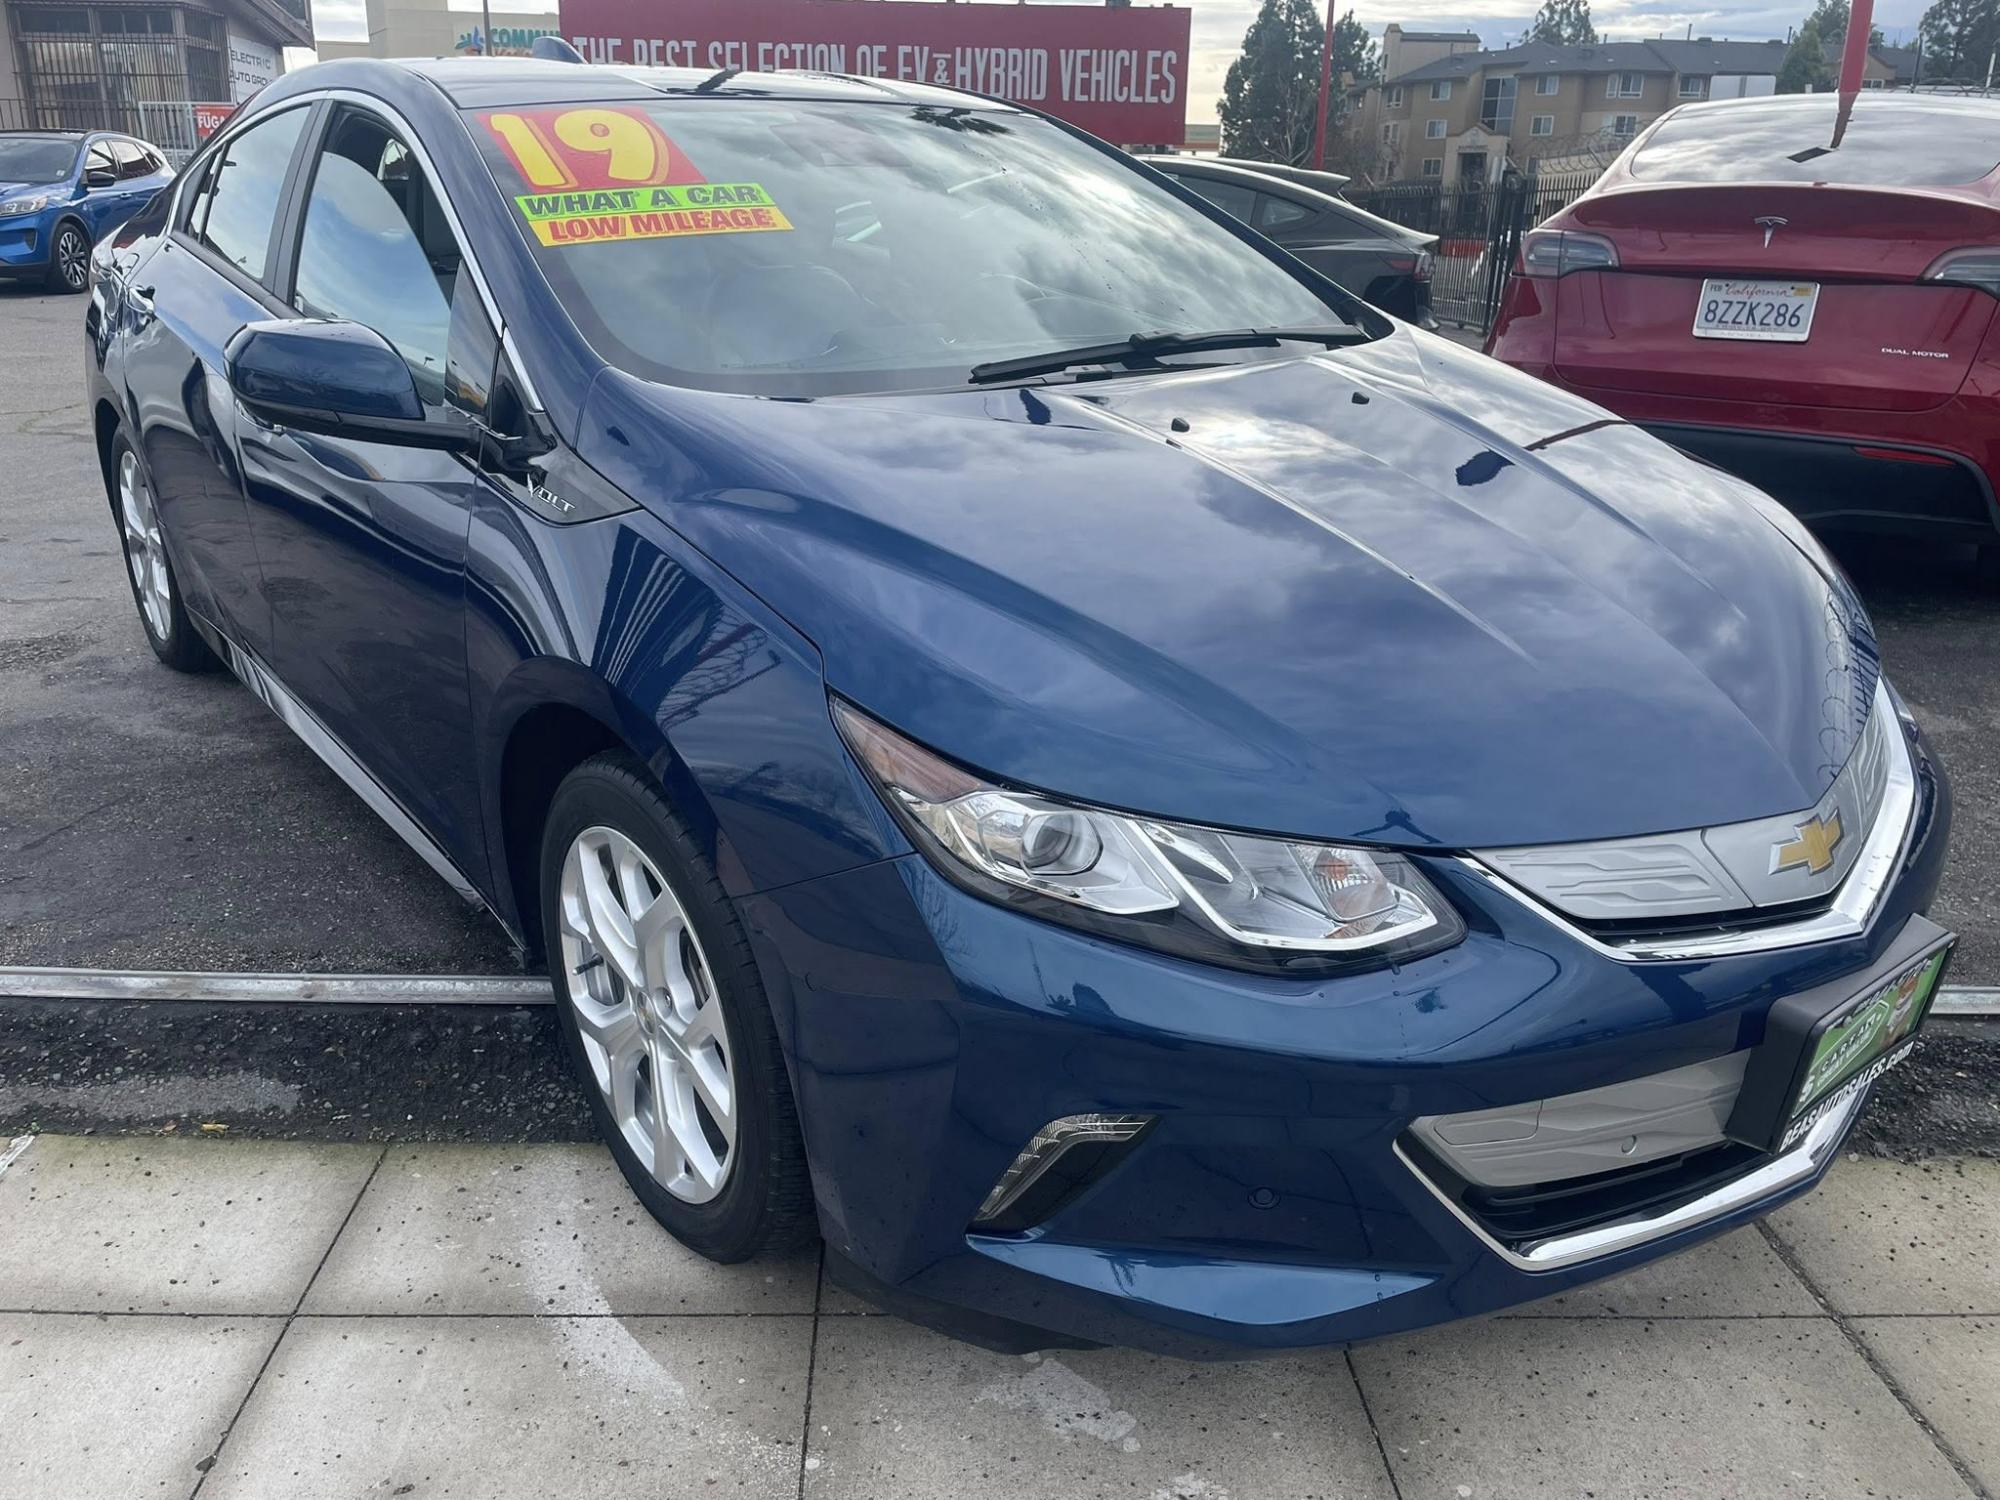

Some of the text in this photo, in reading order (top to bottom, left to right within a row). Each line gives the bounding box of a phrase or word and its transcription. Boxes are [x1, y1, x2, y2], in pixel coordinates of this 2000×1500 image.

[231, 50, 271, 69] ELECTRIC
[573, 37, 1177, 104] THE BEST SELECTION OF EV & HYBRID VEHICLES
[230, 70, 250, 83] AUTO
[490, 109, 666, 188] 19
[523, 185, 762, 215] WHAT A CAR
[549, 208, 778, 242] LOW MILEAGE
[1725, 282, 1794, 299] California
[1704, 300, 1804, 327] 8ZZK286
[1881, 347, 1949, 359] DUAL MOTOR
[527, 473, 575, 512] VOLT
